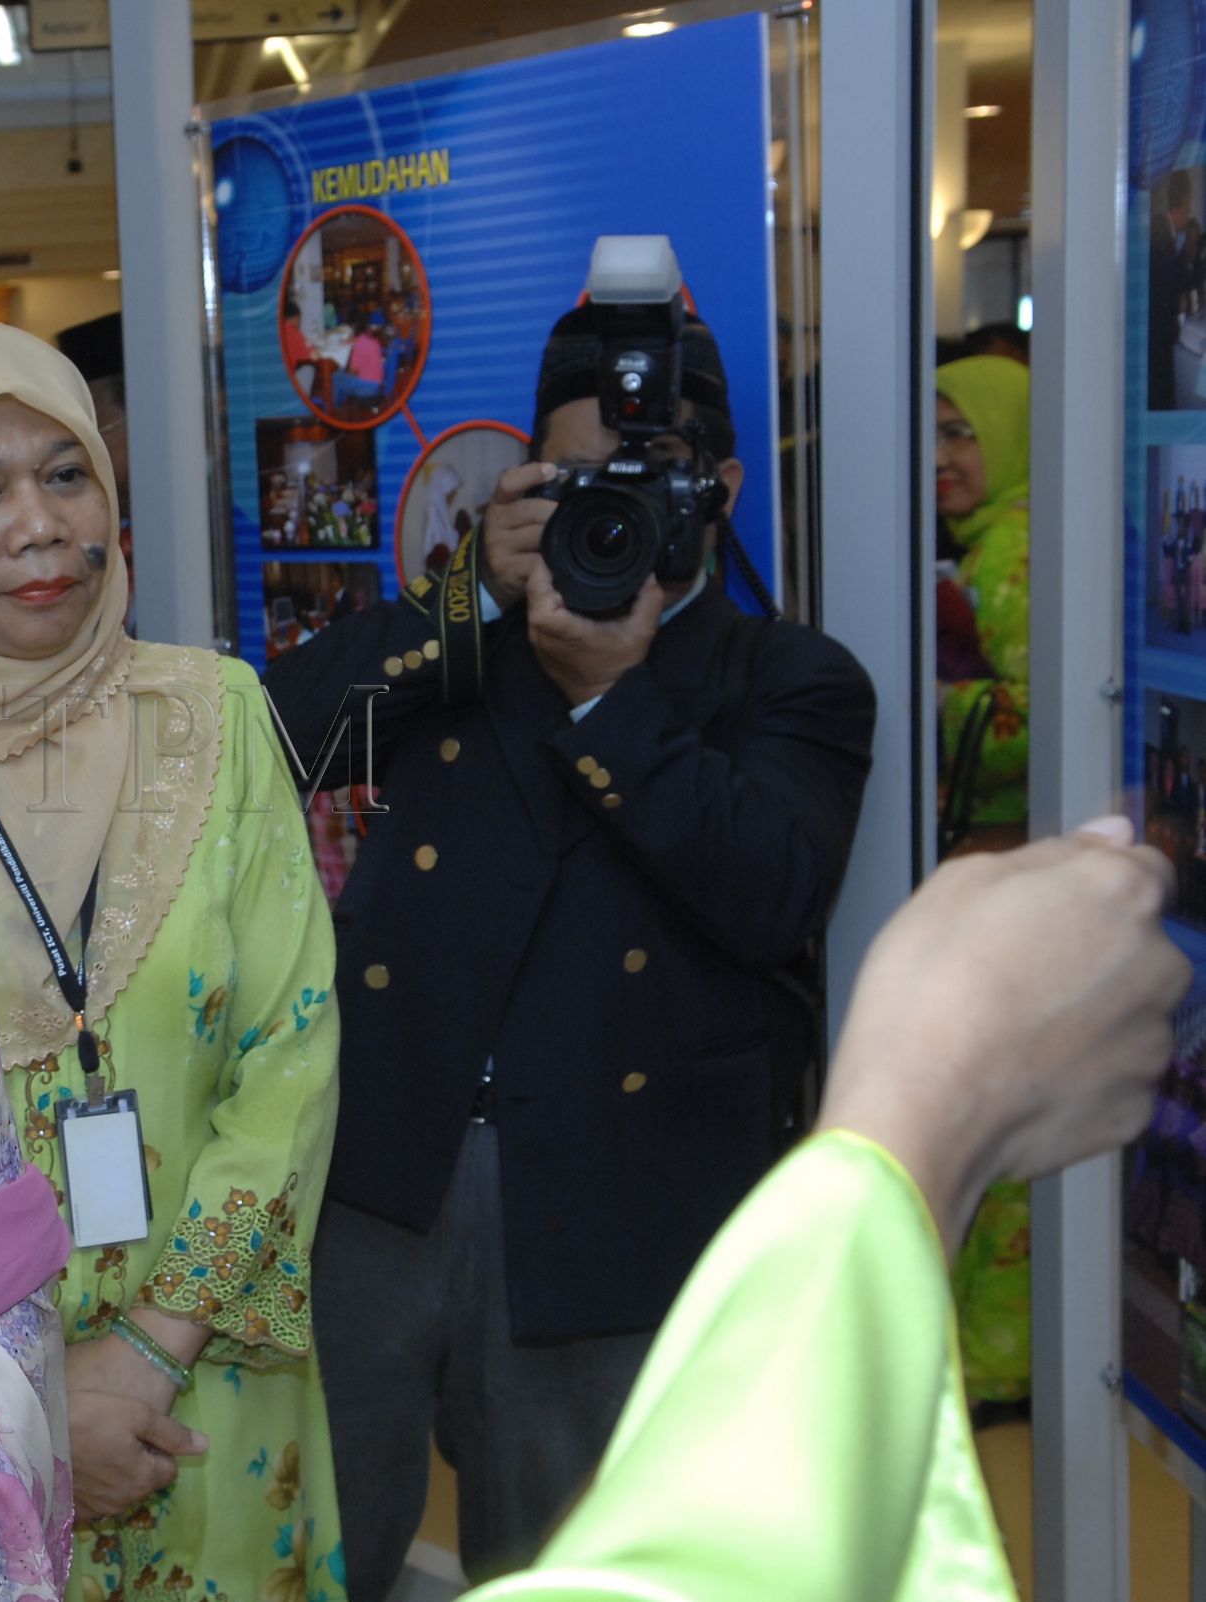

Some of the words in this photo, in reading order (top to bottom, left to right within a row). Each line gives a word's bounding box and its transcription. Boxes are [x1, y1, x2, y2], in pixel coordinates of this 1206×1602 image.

[312, 148, 450, 204] KEMUDAHAN
[607, 462, 643, 474] Nikon
[19, 883, 46, 927] Universiti
[43, 927, 57, 949] ICT,
[51, 948, 67, 977] Pusat
